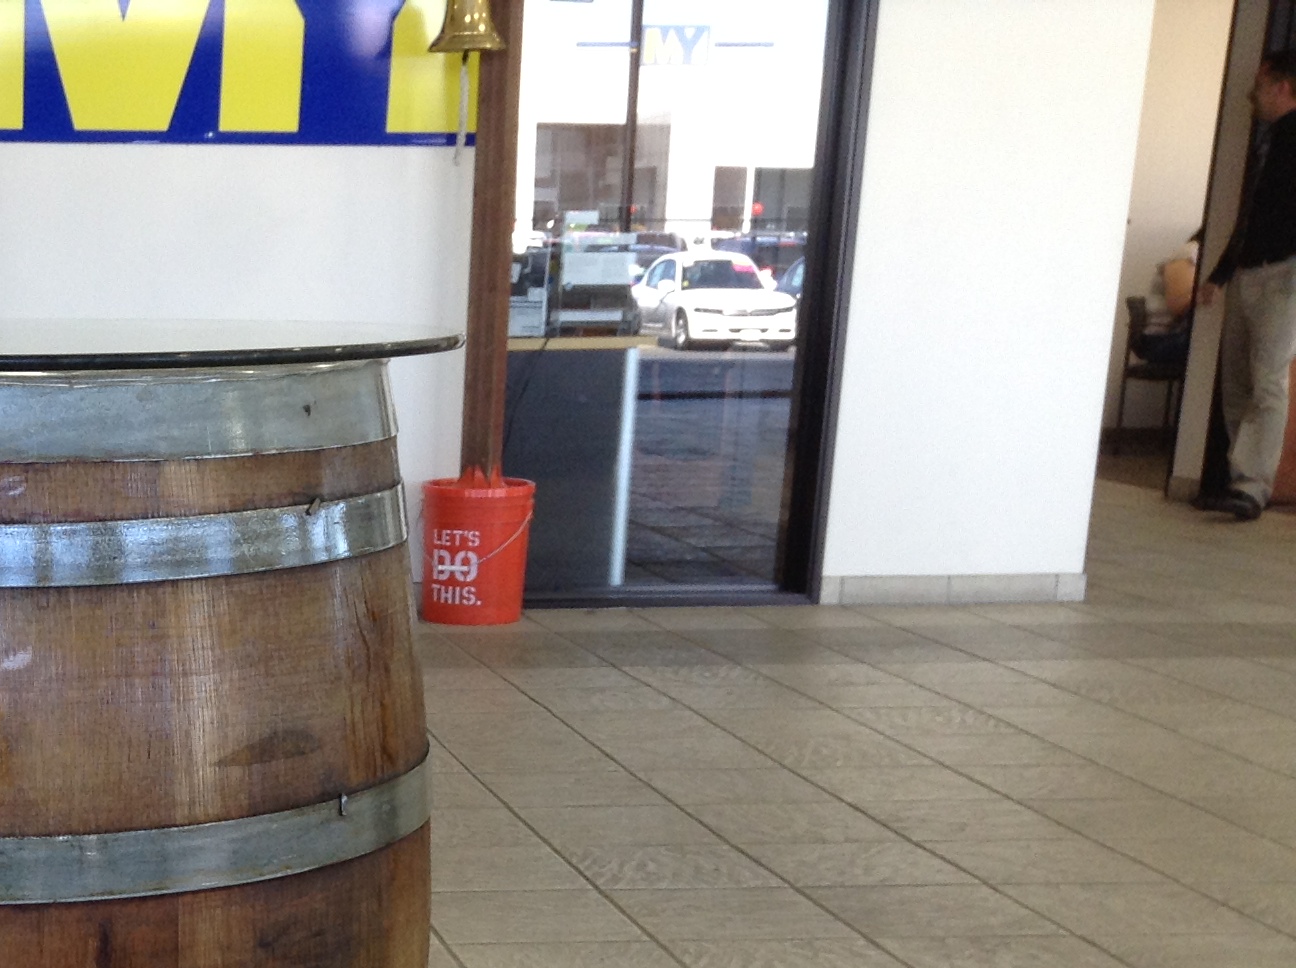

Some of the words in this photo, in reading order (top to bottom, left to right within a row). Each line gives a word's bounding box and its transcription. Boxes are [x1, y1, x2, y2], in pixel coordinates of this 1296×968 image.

[433, 528, 481, 547] LET'S
[432, 548, 479, 582] DO
[431, 583, 482, 606] THIS.
